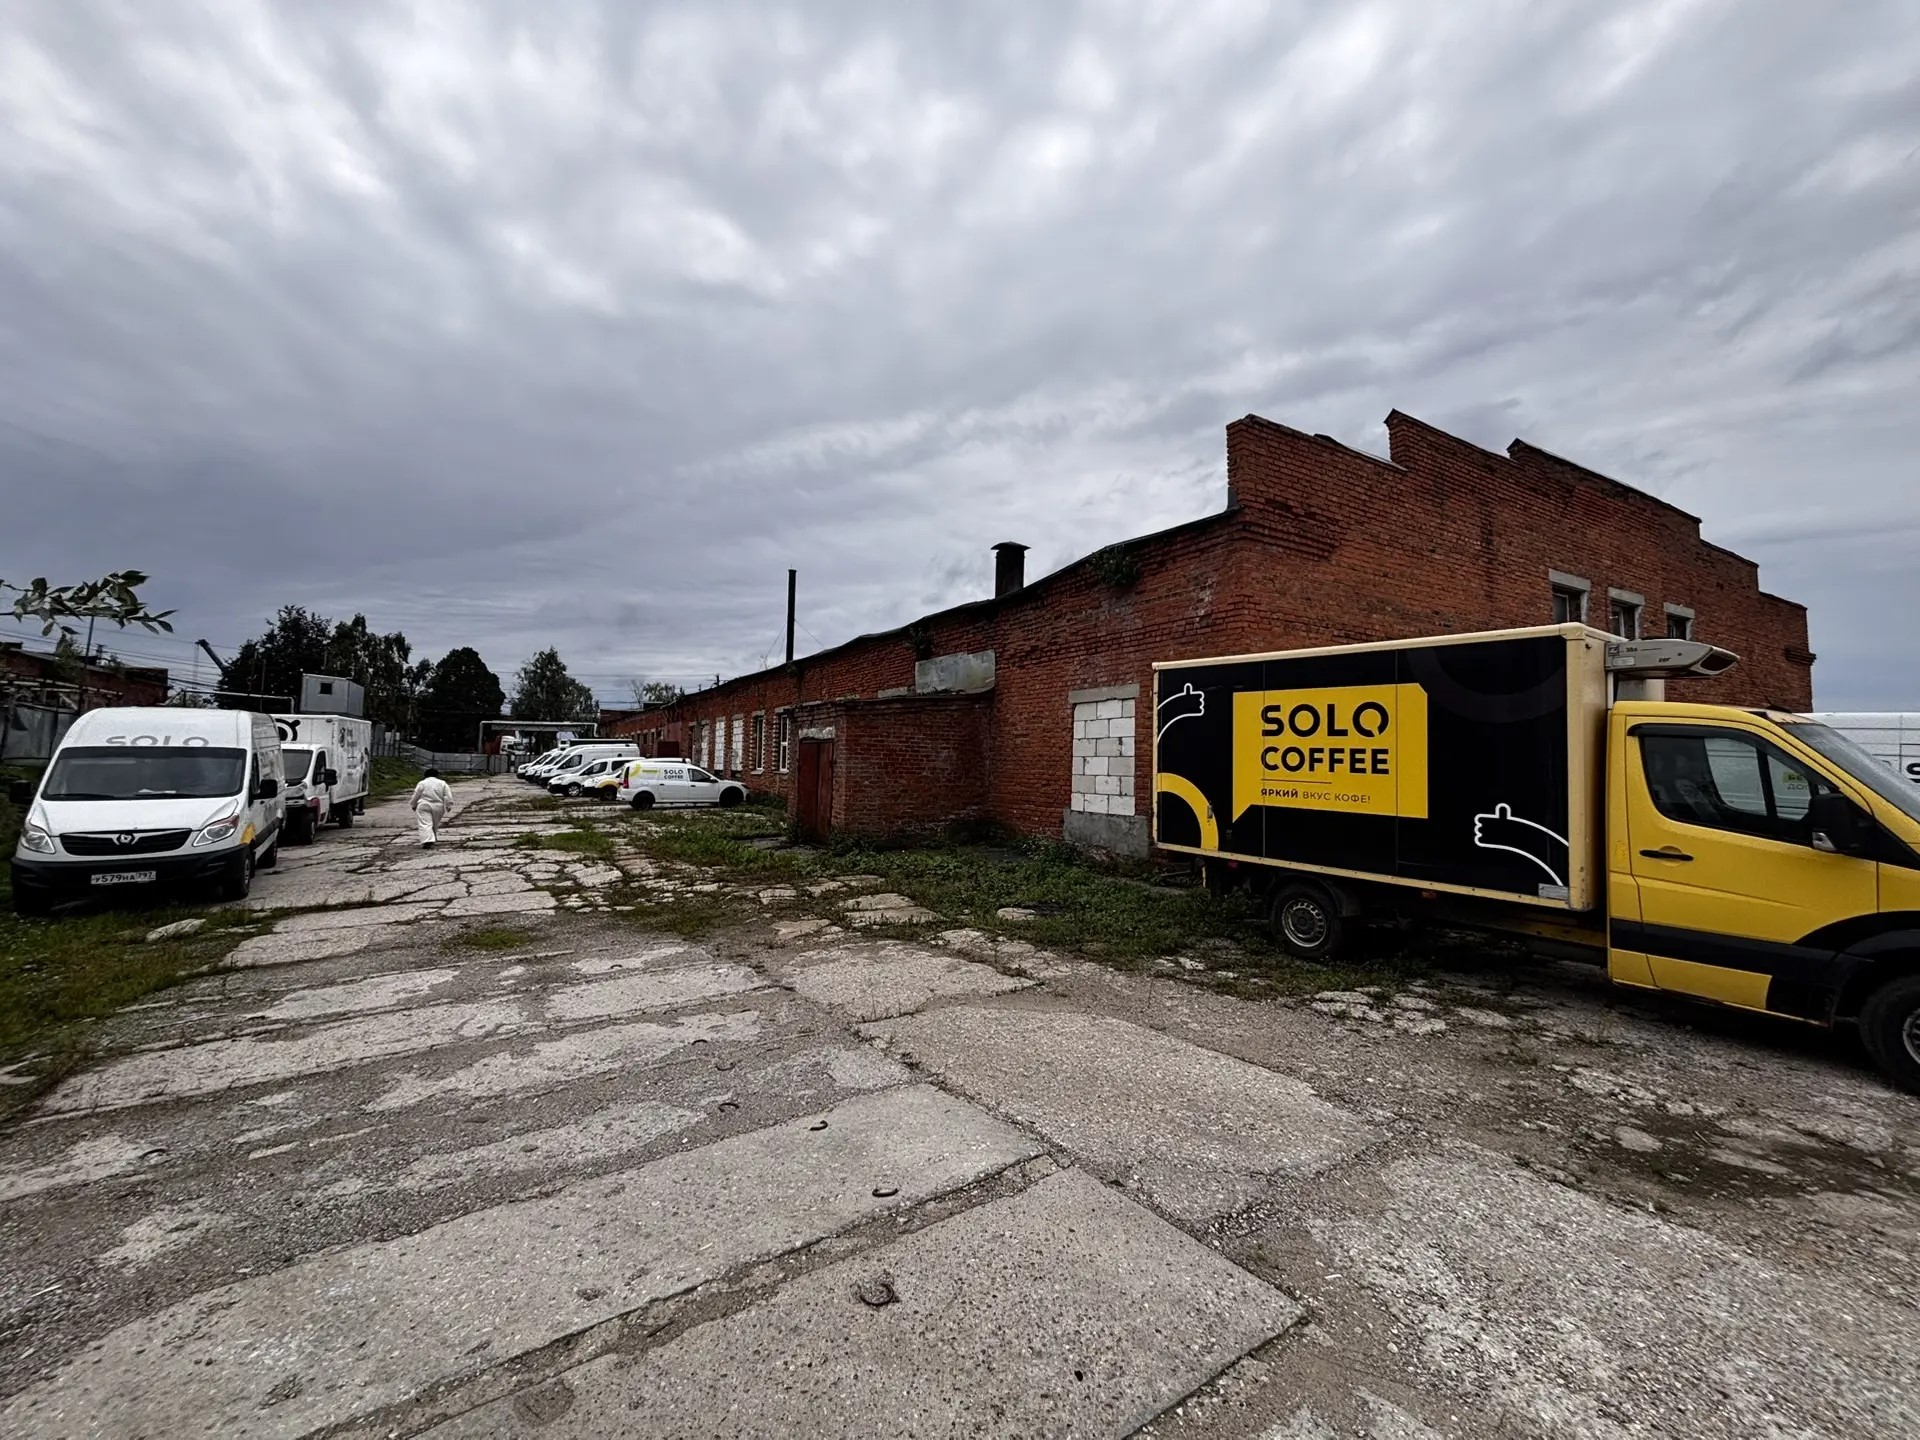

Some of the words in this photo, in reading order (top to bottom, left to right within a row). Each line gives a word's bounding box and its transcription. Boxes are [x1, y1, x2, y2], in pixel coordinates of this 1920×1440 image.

[1260, 701, 1390, 738] SOLO
[1260, 746, 1390, 775] COFFEE
[1260, 787, 1299, 799] ЯРКИЙ
[1302, 791, 1332, 801] ВКУС
[1334, 793, 1372, 804] КОФЕ!
